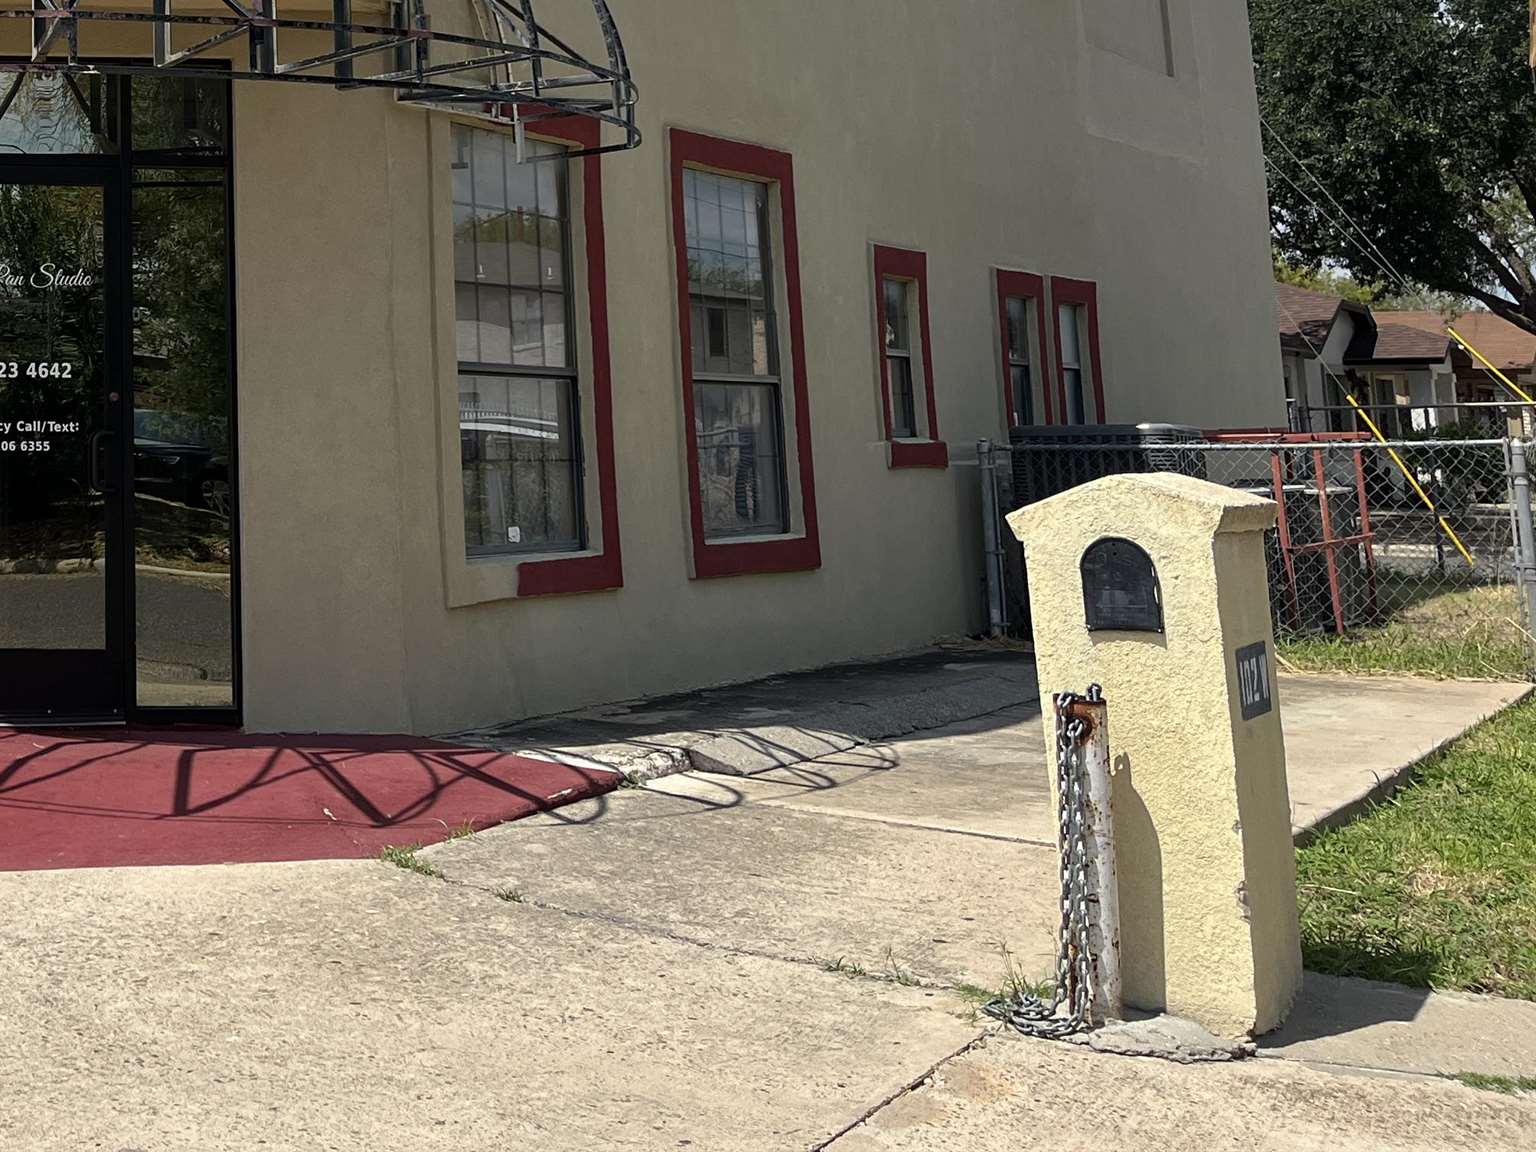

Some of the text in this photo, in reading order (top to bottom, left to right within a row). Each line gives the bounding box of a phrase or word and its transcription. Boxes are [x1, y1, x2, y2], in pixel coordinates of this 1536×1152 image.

[30, 263, 94, 288] Studio
[26, 362, 72, 378] 4642
[16, 420, 80, 433] Call/Text:
[20, 441, 51, 452] 6355
